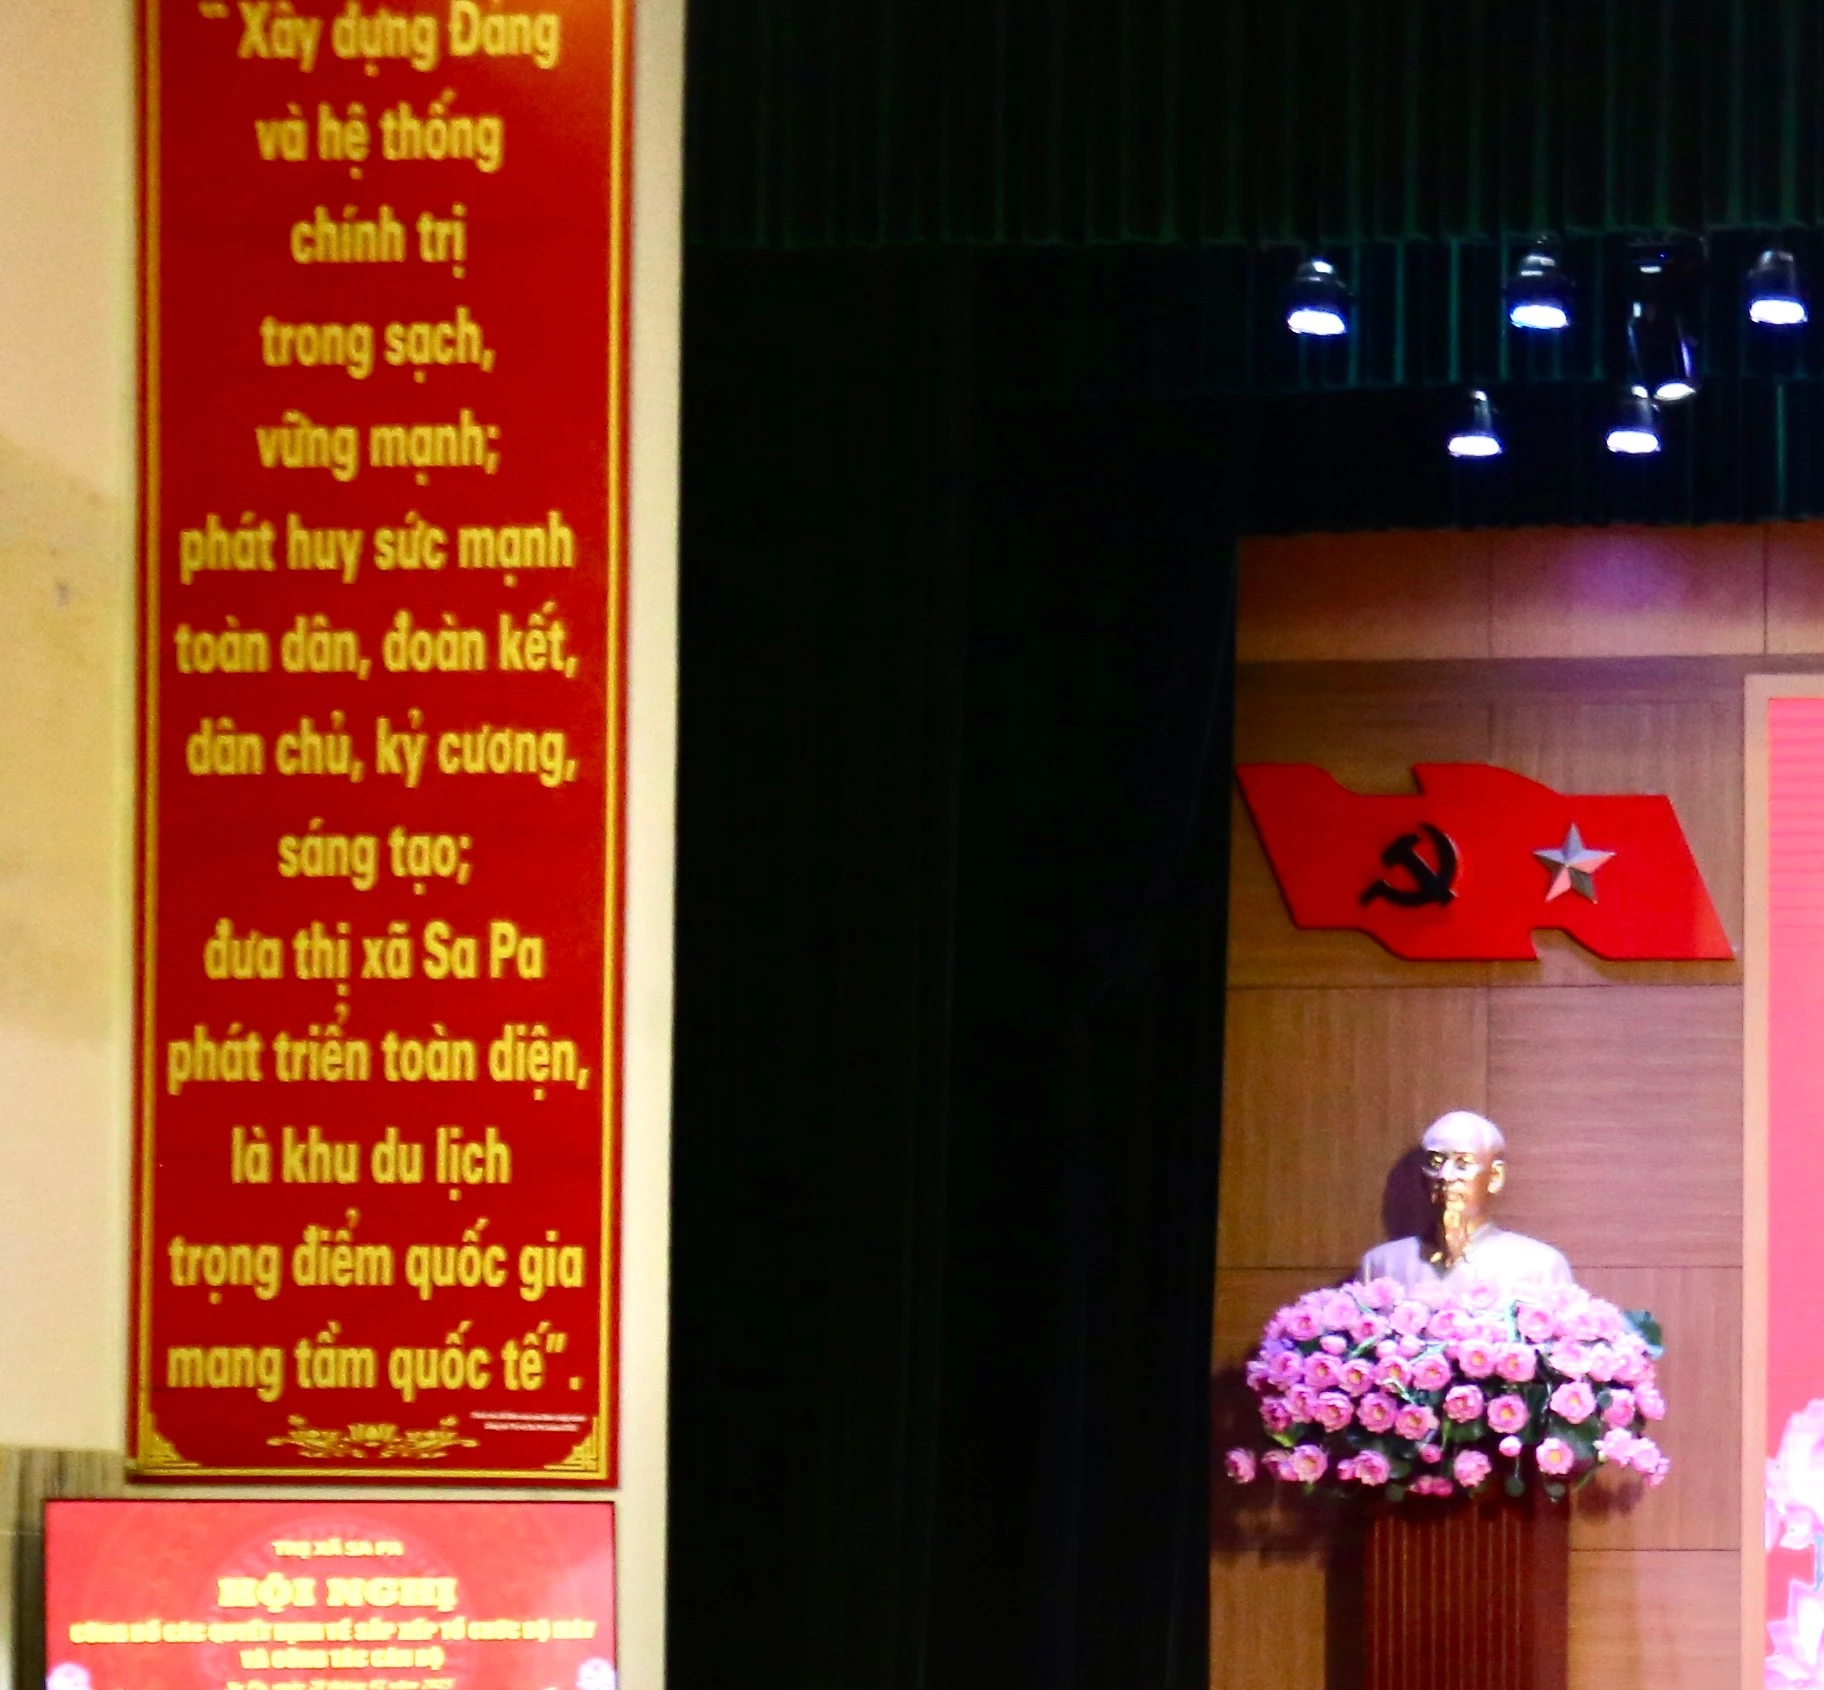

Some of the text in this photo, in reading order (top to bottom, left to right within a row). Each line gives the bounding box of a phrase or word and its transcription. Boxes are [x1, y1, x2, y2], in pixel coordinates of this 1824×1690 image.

[254, 89, 504, 179] và hệ thống
[290, 203, 467, 279] chính trị
[259, 305, 495, 384] trong sạch,
[255, 407, 500, 487] vững mạnh;
[180, 509, 576, 588] phát huy sức mạnh
[174, 600, 579, 680] toàn dân, đoàn kết,
[186, 716, 264, 776] dân
[275, 709, 364, 783] chủ,
[278, 817, 472, 896] sáng tạo;
[204, 917, 545, 997] đưa thị xã Sa Pa
[167, 1003, 591, 1102] phát triển toàn diện,
[231, 1125, 512, 1202] là khu du lịch
[167, 1207, 585, 1305] trọng điểm quốc gia
[166, 1345, 284, 1403] mang
[293, 1320, 377, 1390] tầm
[387, 1319, 492, 1404] quốc
